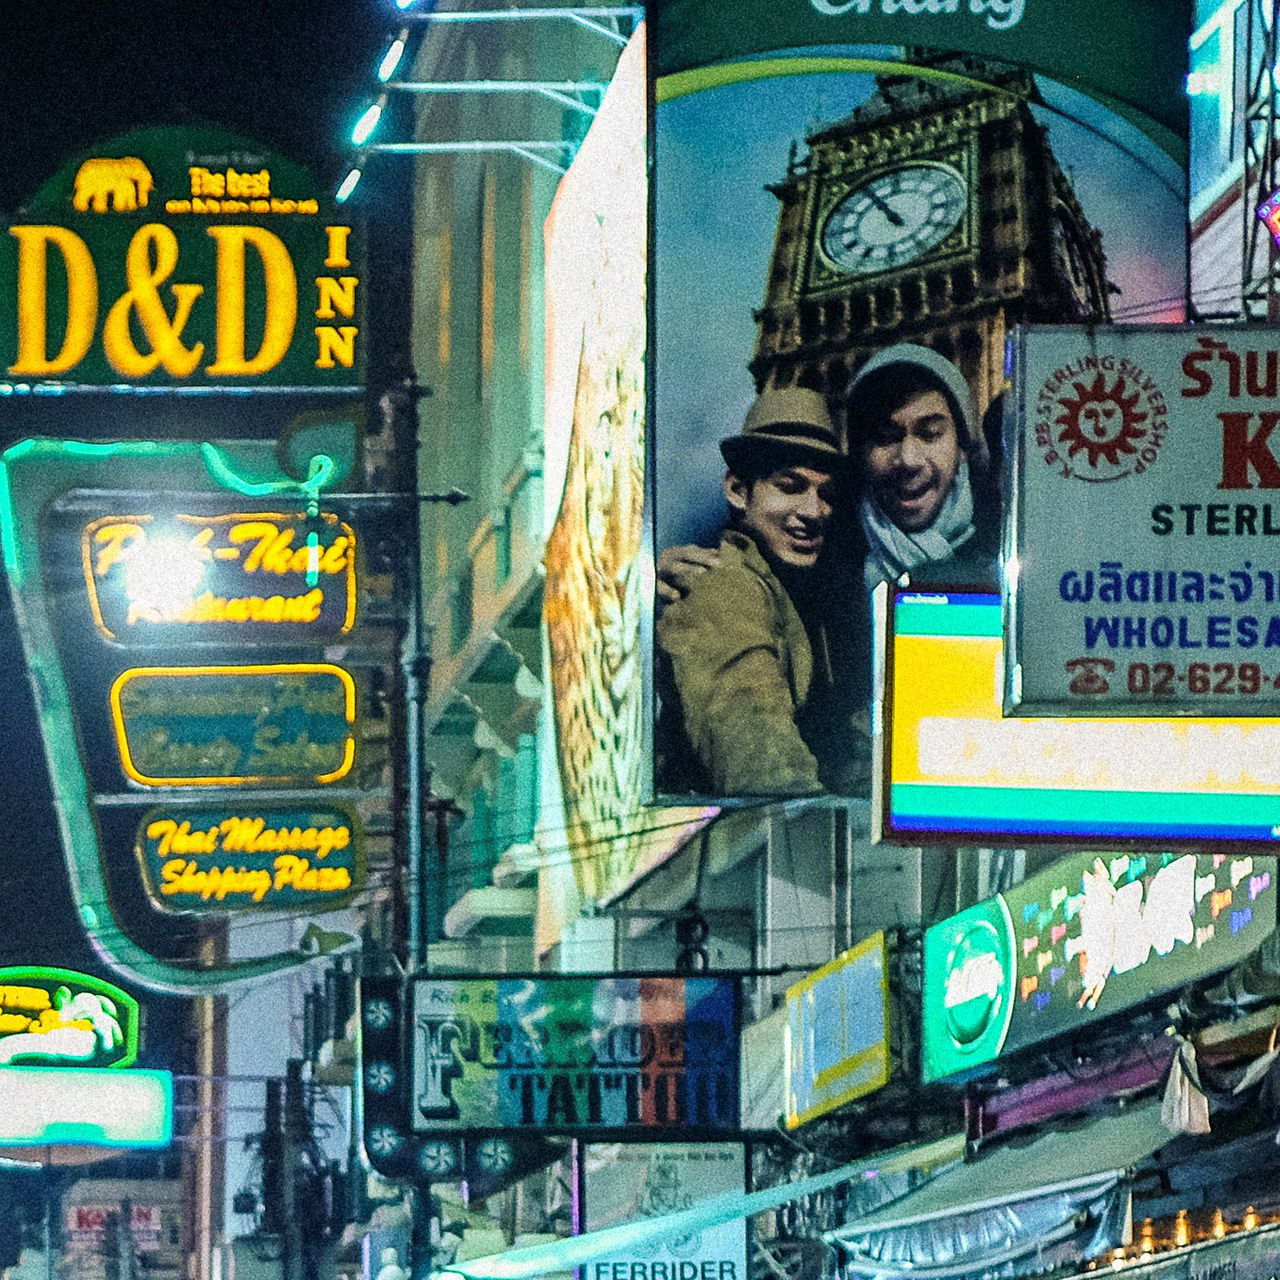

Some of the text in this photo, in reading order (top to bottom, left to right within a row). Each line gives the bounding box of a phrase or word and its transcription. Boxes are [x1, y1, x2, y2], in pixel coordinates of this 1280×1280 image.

[7, 223, 298, 377] D&D
[314, 226, 358, 368] INN
[220, 817, 350, 859] Massage
